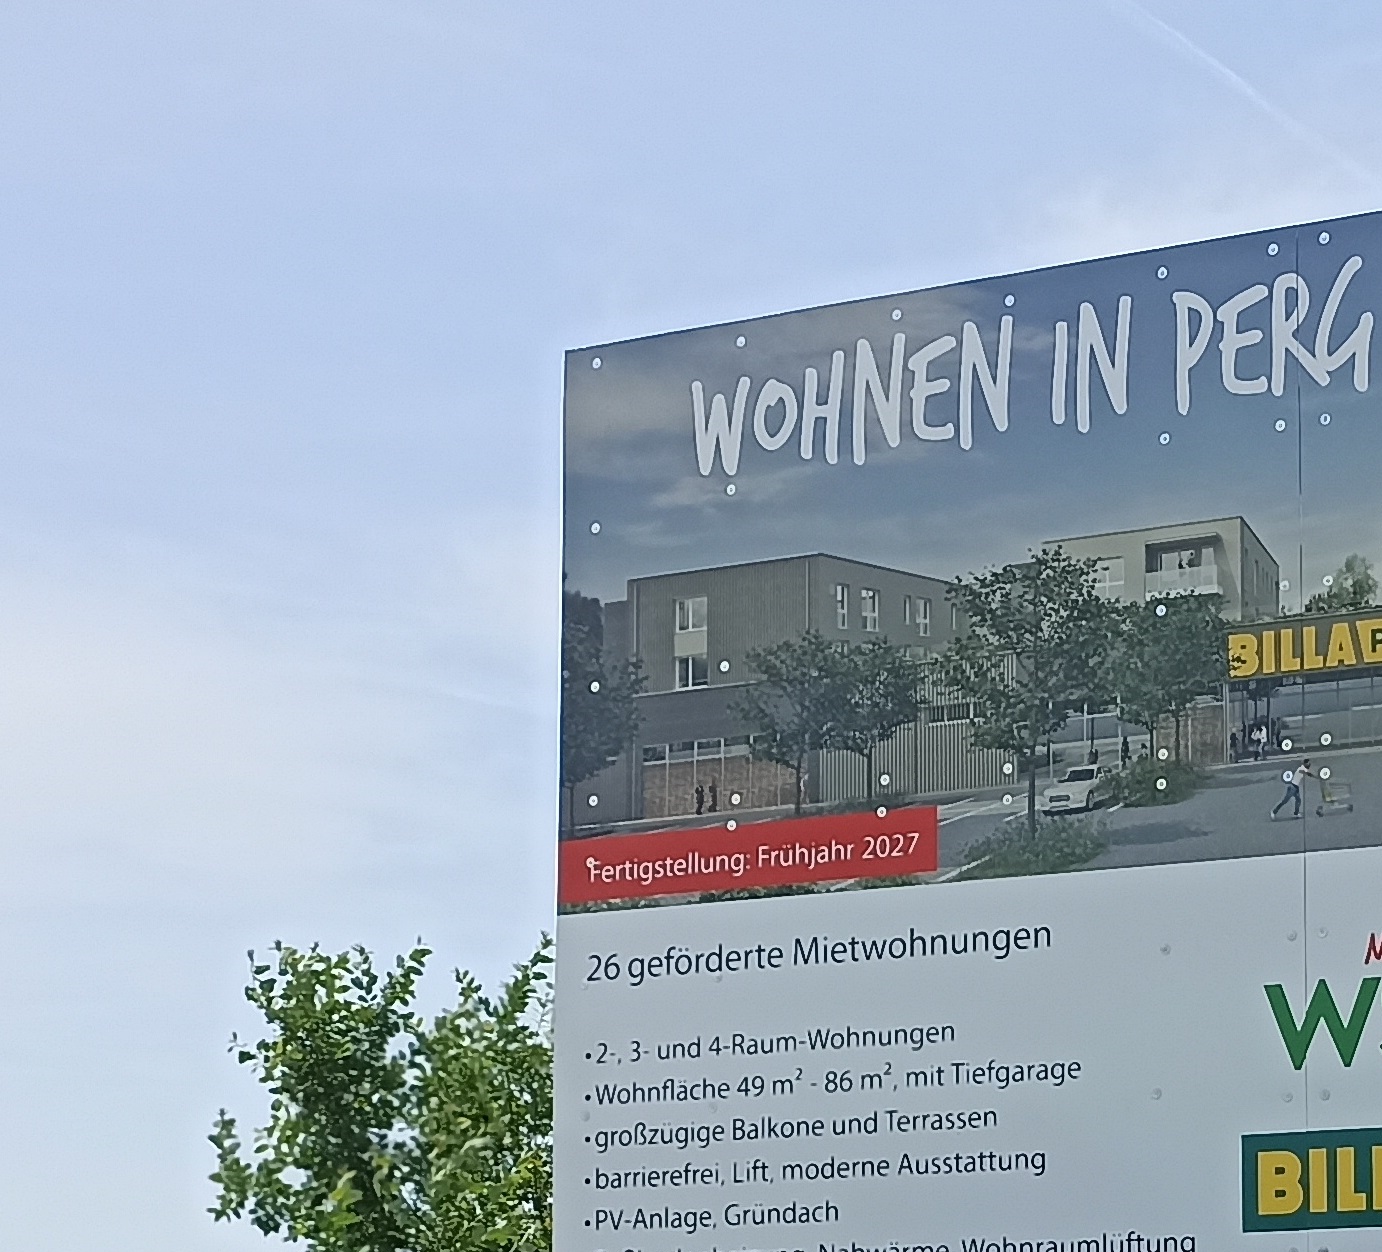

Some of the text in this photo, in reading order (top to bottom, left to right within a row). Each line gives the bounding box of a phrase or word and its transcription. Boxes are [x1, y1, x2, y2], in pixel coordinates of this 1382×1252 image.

[691, 313, 1014, 477] WOHNEN
[1051, 295, 1132, 434] IN
[1172, 255, 1374, 416] PERG
[1228, 621, 1356, 678] BILLA
[588, 832, 920, 886] Fertigstellung: Frühjahr 2027
[587, 923, 1051, 987] 26 geförderte Mietwohnungen
[657, 1035, 701, 1061] und
[708, 1022, 956, 1059] 4-Raum-Wohnungen
[595, 1077, 731, 1106] Wohnfläche
[736, 1075, 765, 1098] 49
[772, 1067, 803, 1096] m²
[824, 1069, 854, 1094] 86
[905, 1064, 945, 1088] mit
[951, 1058, 1082, 1090] Tiefgarage
[594, 1107, 998, 1154] großzügige Balkone und Terrassen
[595, 1148, 1047, 1190] barrierefrei, Lift, moderne Ausstattung
[595, 1199, 839, 1235] PV-Anlage, Gründach
